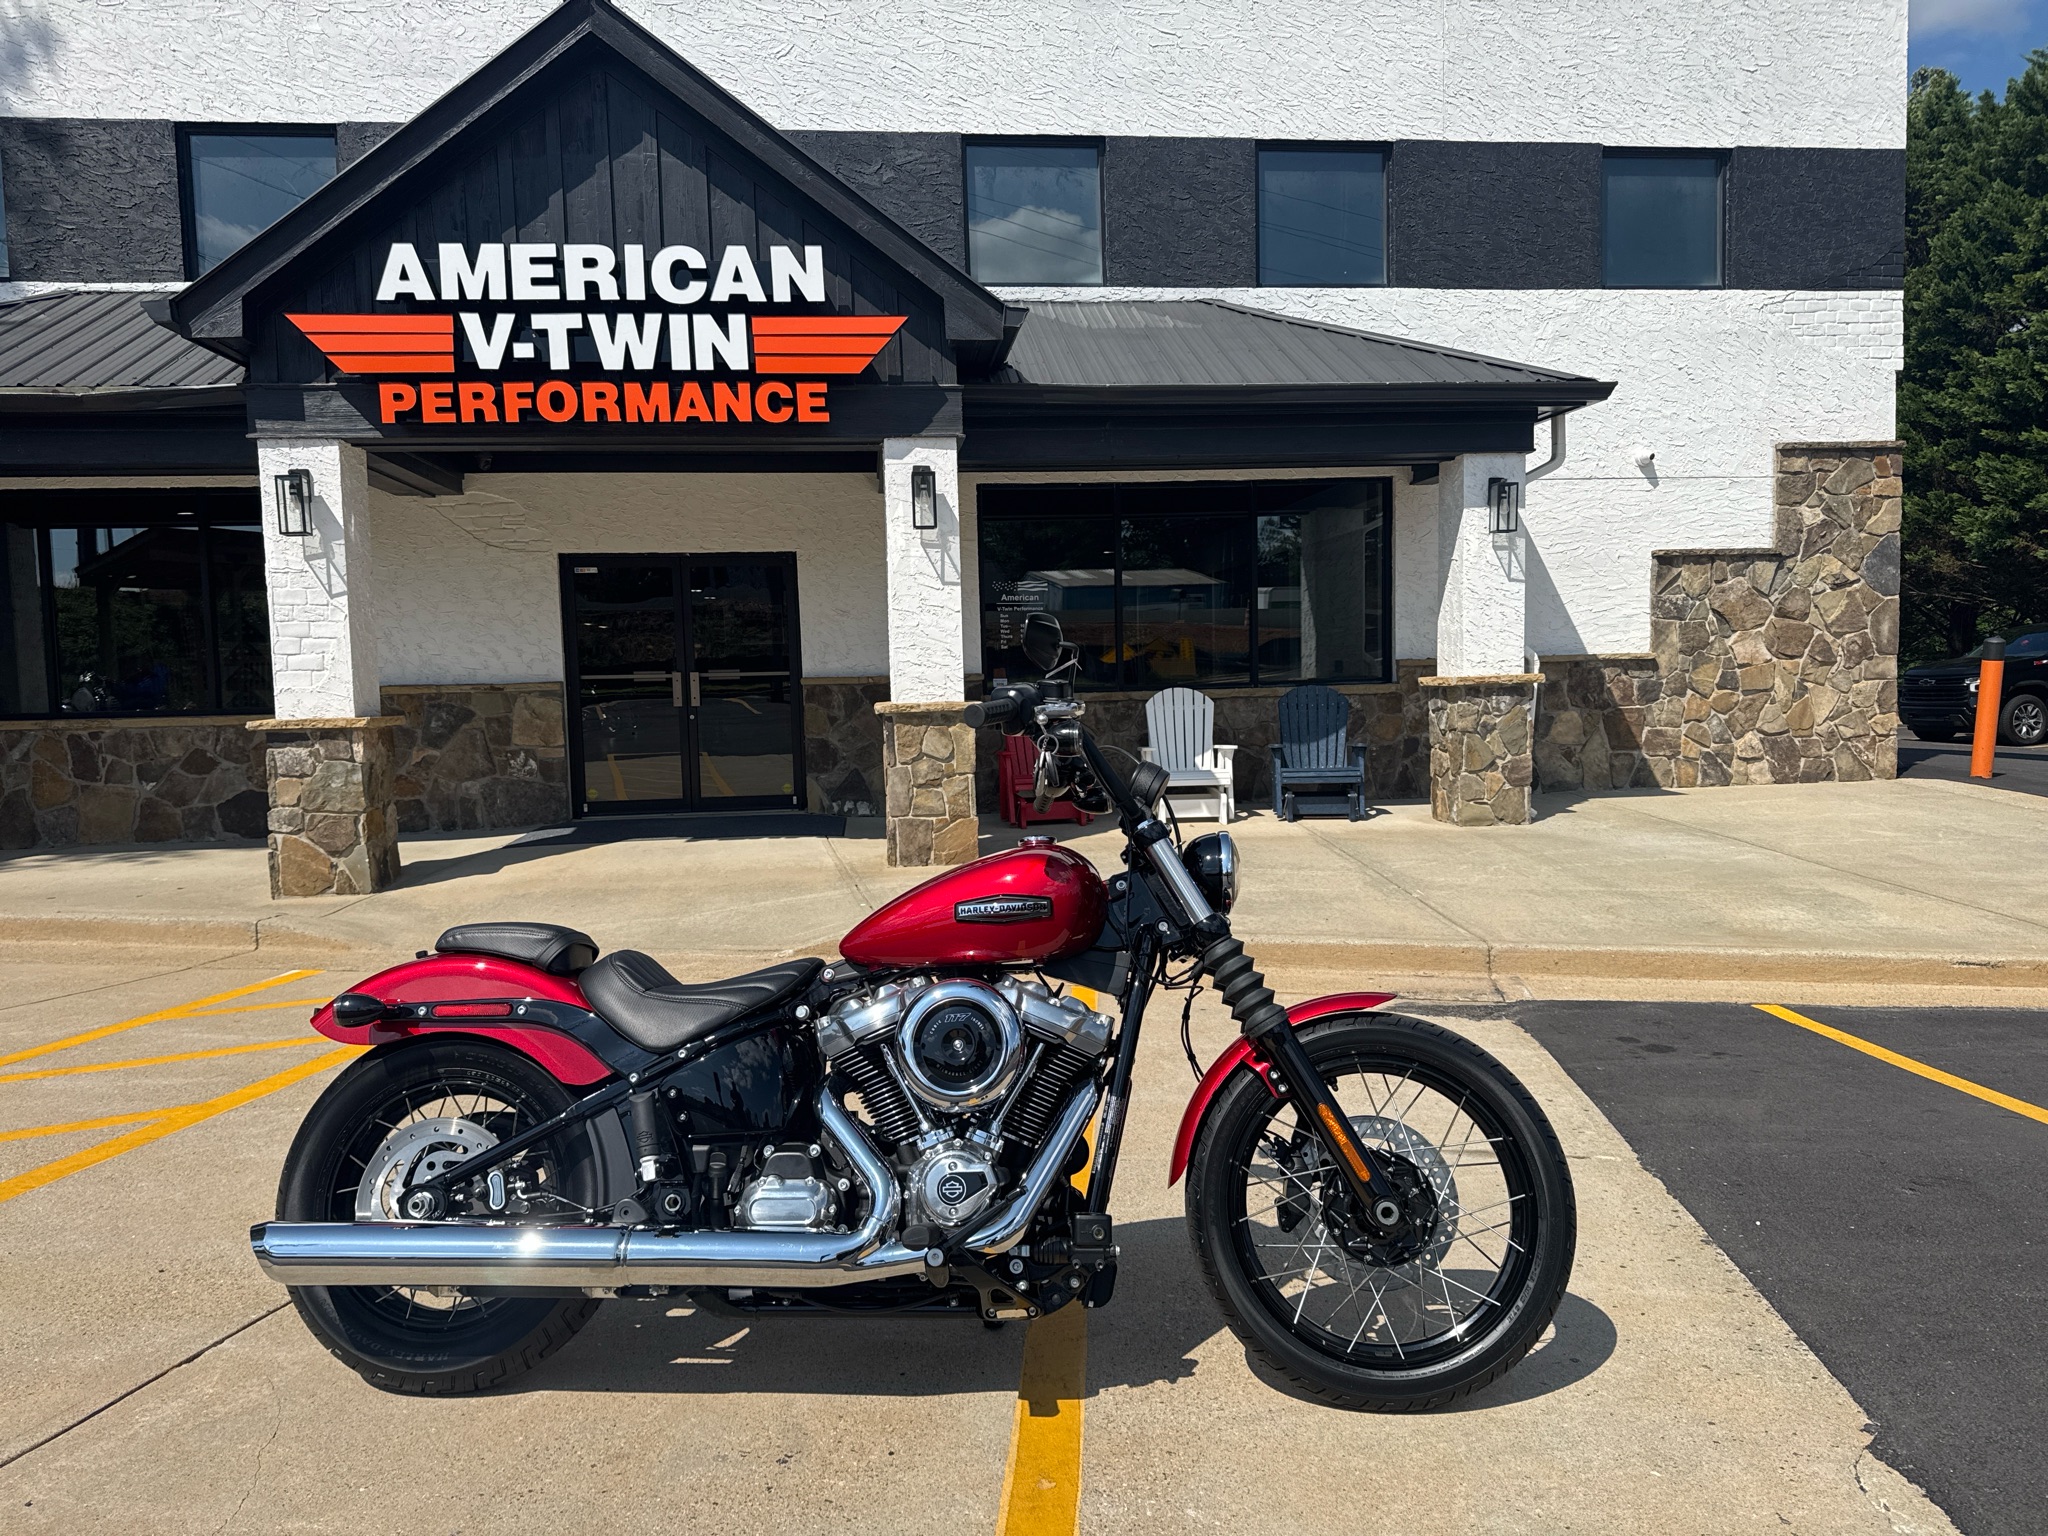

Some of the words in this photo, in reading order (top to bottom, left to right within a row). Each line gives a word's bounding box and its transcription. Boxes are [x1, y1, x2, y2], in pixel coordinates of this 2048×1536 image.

[376, 242, 826, 304] AMERICAN
[459, 312, 750, 371] V-TWIN
[378, 380, 830, 424] PERFORMANCE
[960, 903, 1047, 915] HARLEY-DAVIDSON
[944, 1012, 972, 1024] 117
